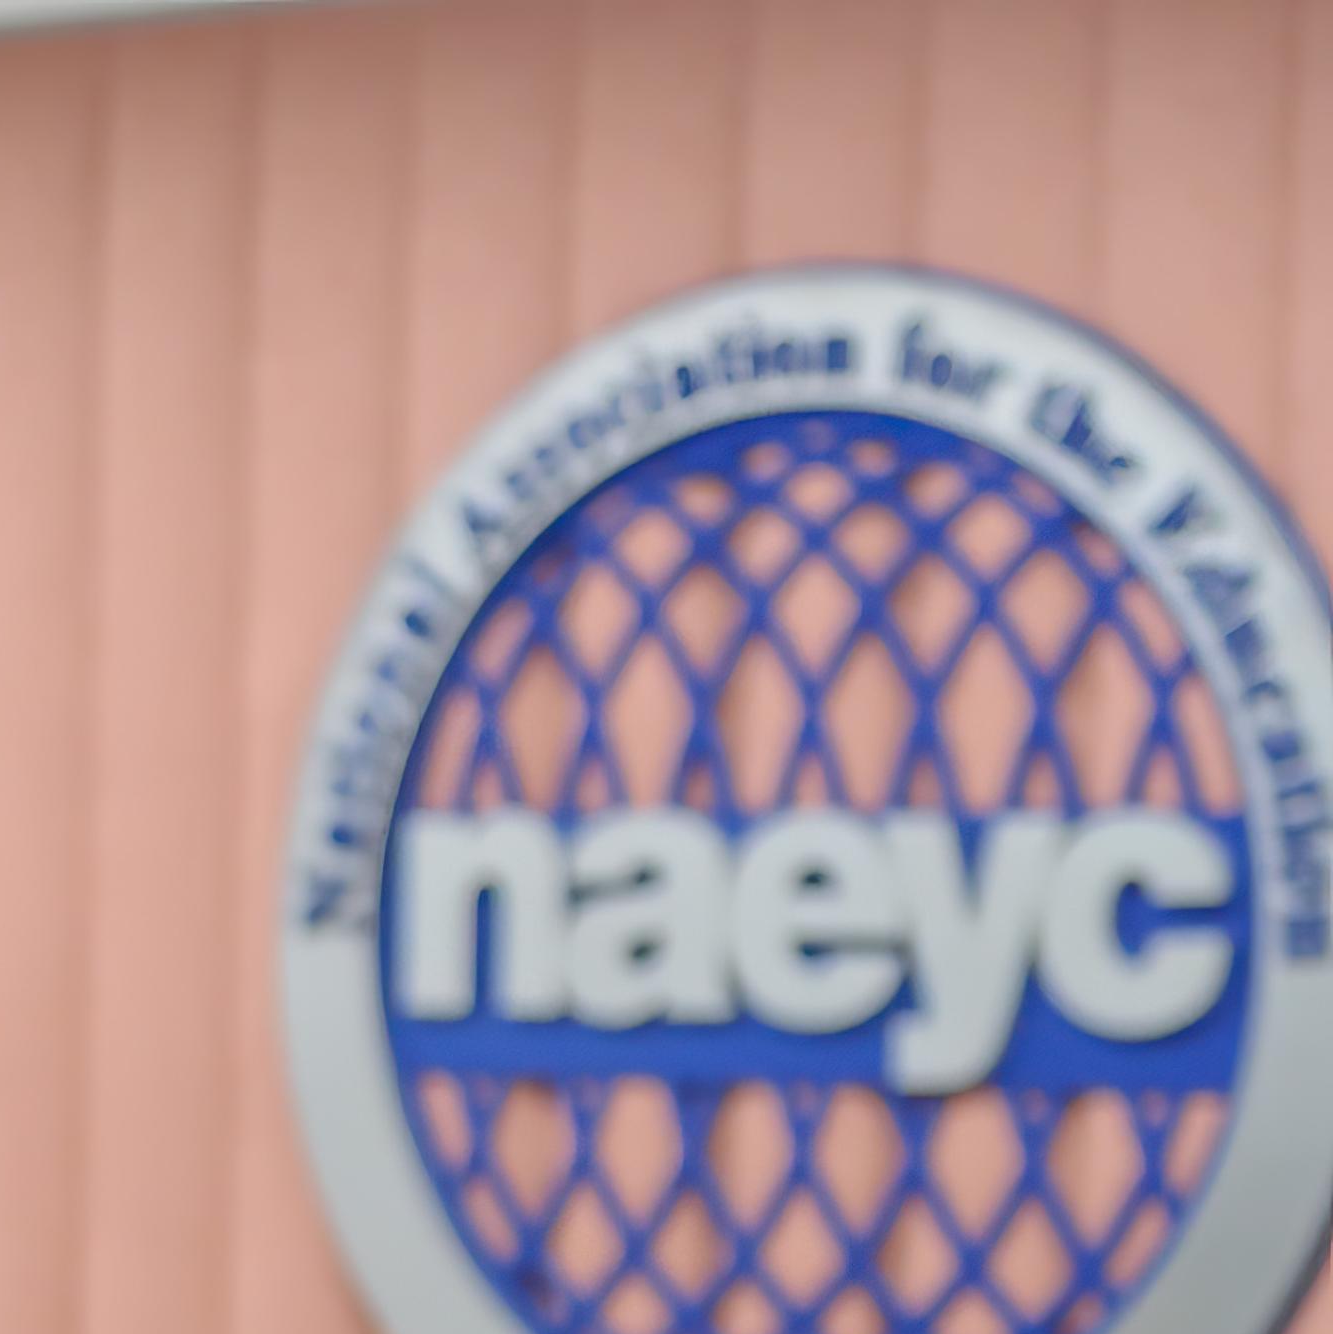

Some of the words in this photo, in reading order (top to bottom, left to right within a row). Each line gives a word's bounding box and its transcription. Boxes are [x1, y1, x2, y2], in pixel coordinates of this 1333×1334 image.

[459, 318, 855, 550] Association
[895, 318, 1005, 405] for
[1027, 378, 1135, 488] the
[397, 806, 1235, 1094] naeyc
